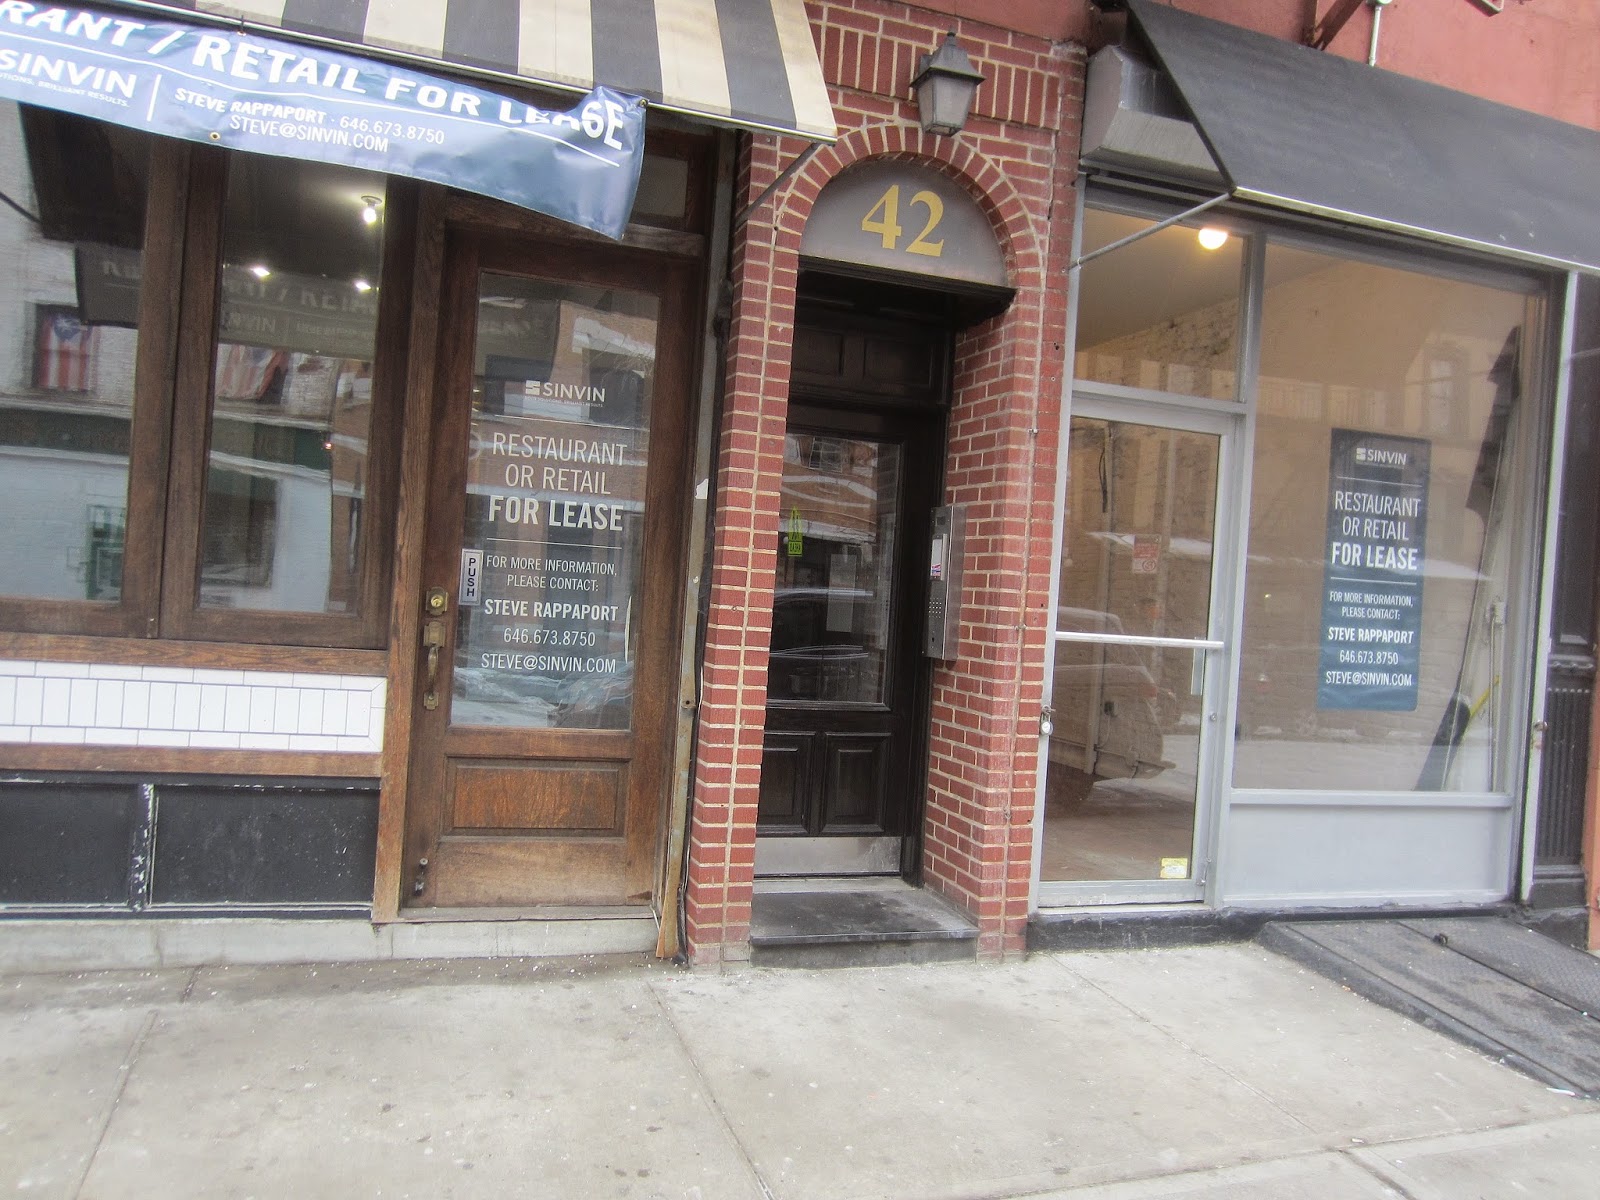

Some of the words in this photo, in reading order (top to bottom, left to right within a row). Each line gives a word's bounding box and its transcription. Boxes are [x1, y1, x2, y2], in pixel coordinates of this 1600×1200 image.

[0, 0, 146, 47] RANT
[192, 34, 367, 94] RETAIL
[384, 77, 481, 116] FOR
[0, 48, 137, 98] SINVIN
[174, 87, 227, 113] STEVE
[230, 101, 327, 125] RAPPAPORT
[339, 115, 445, 145] 646.673.8750
[229, 115, 389, 153] STEVE@SINVIN.COM
[861, 184, 944, 257] 42
[542, 382, 606, 402] SINVIN
[492, 432, 628, 466] RESTAURANT
[1366, 449, 1407, 466] SINVIN
[505, 463, 534, 488] OR
[543, 468, 611, 495] RETAIL
[488, 495, 540, 525] FOR
[549, 499, 624, 531] LEASE
[1334, 490, 1421, 518] RESTAURANT
[1342, 515, 1360, 537] OR
[1363, 518, 1409, 542] RETAIL
[486, 555, 507, 568] FOR
[510, 558, 542, 571] MORE
[545, 559, 617, 576] INFORMATION,
[1331, 541, 1362, 567] FOR
[1366, 544, 1418, 571] LEASE
[467, 557, 477, 597] PUSH
[507, 574, 546, 589] PLEASE
[549, 576, 599, 592] CONTACT:
[484, 598, 528, 617] STEVE
[533, 600, 619, 621] RAPPAPORT
[1329, 590, 1343, 602] FOR
[1343, 592, 1363, 604] MORE
[1363, 593, 1414, 608] INFORMATION,
[1341, 605, 1366, 618] PLEASE
[1366, 608, 1401, 620] CONTACT:
[503, 627, 596, 647] 646.673.8750
[1327, 626, 1355, 641] STEVE
[1357, 628, 1415, 644] RAPPAPORT
[481, 652, 617, 673] STEVE@SINVIN.COM
[1339, 649, 1399, 665] 646.673.8750
[1325, 671, 1413, 687] STEVE@SINVIN.COM
